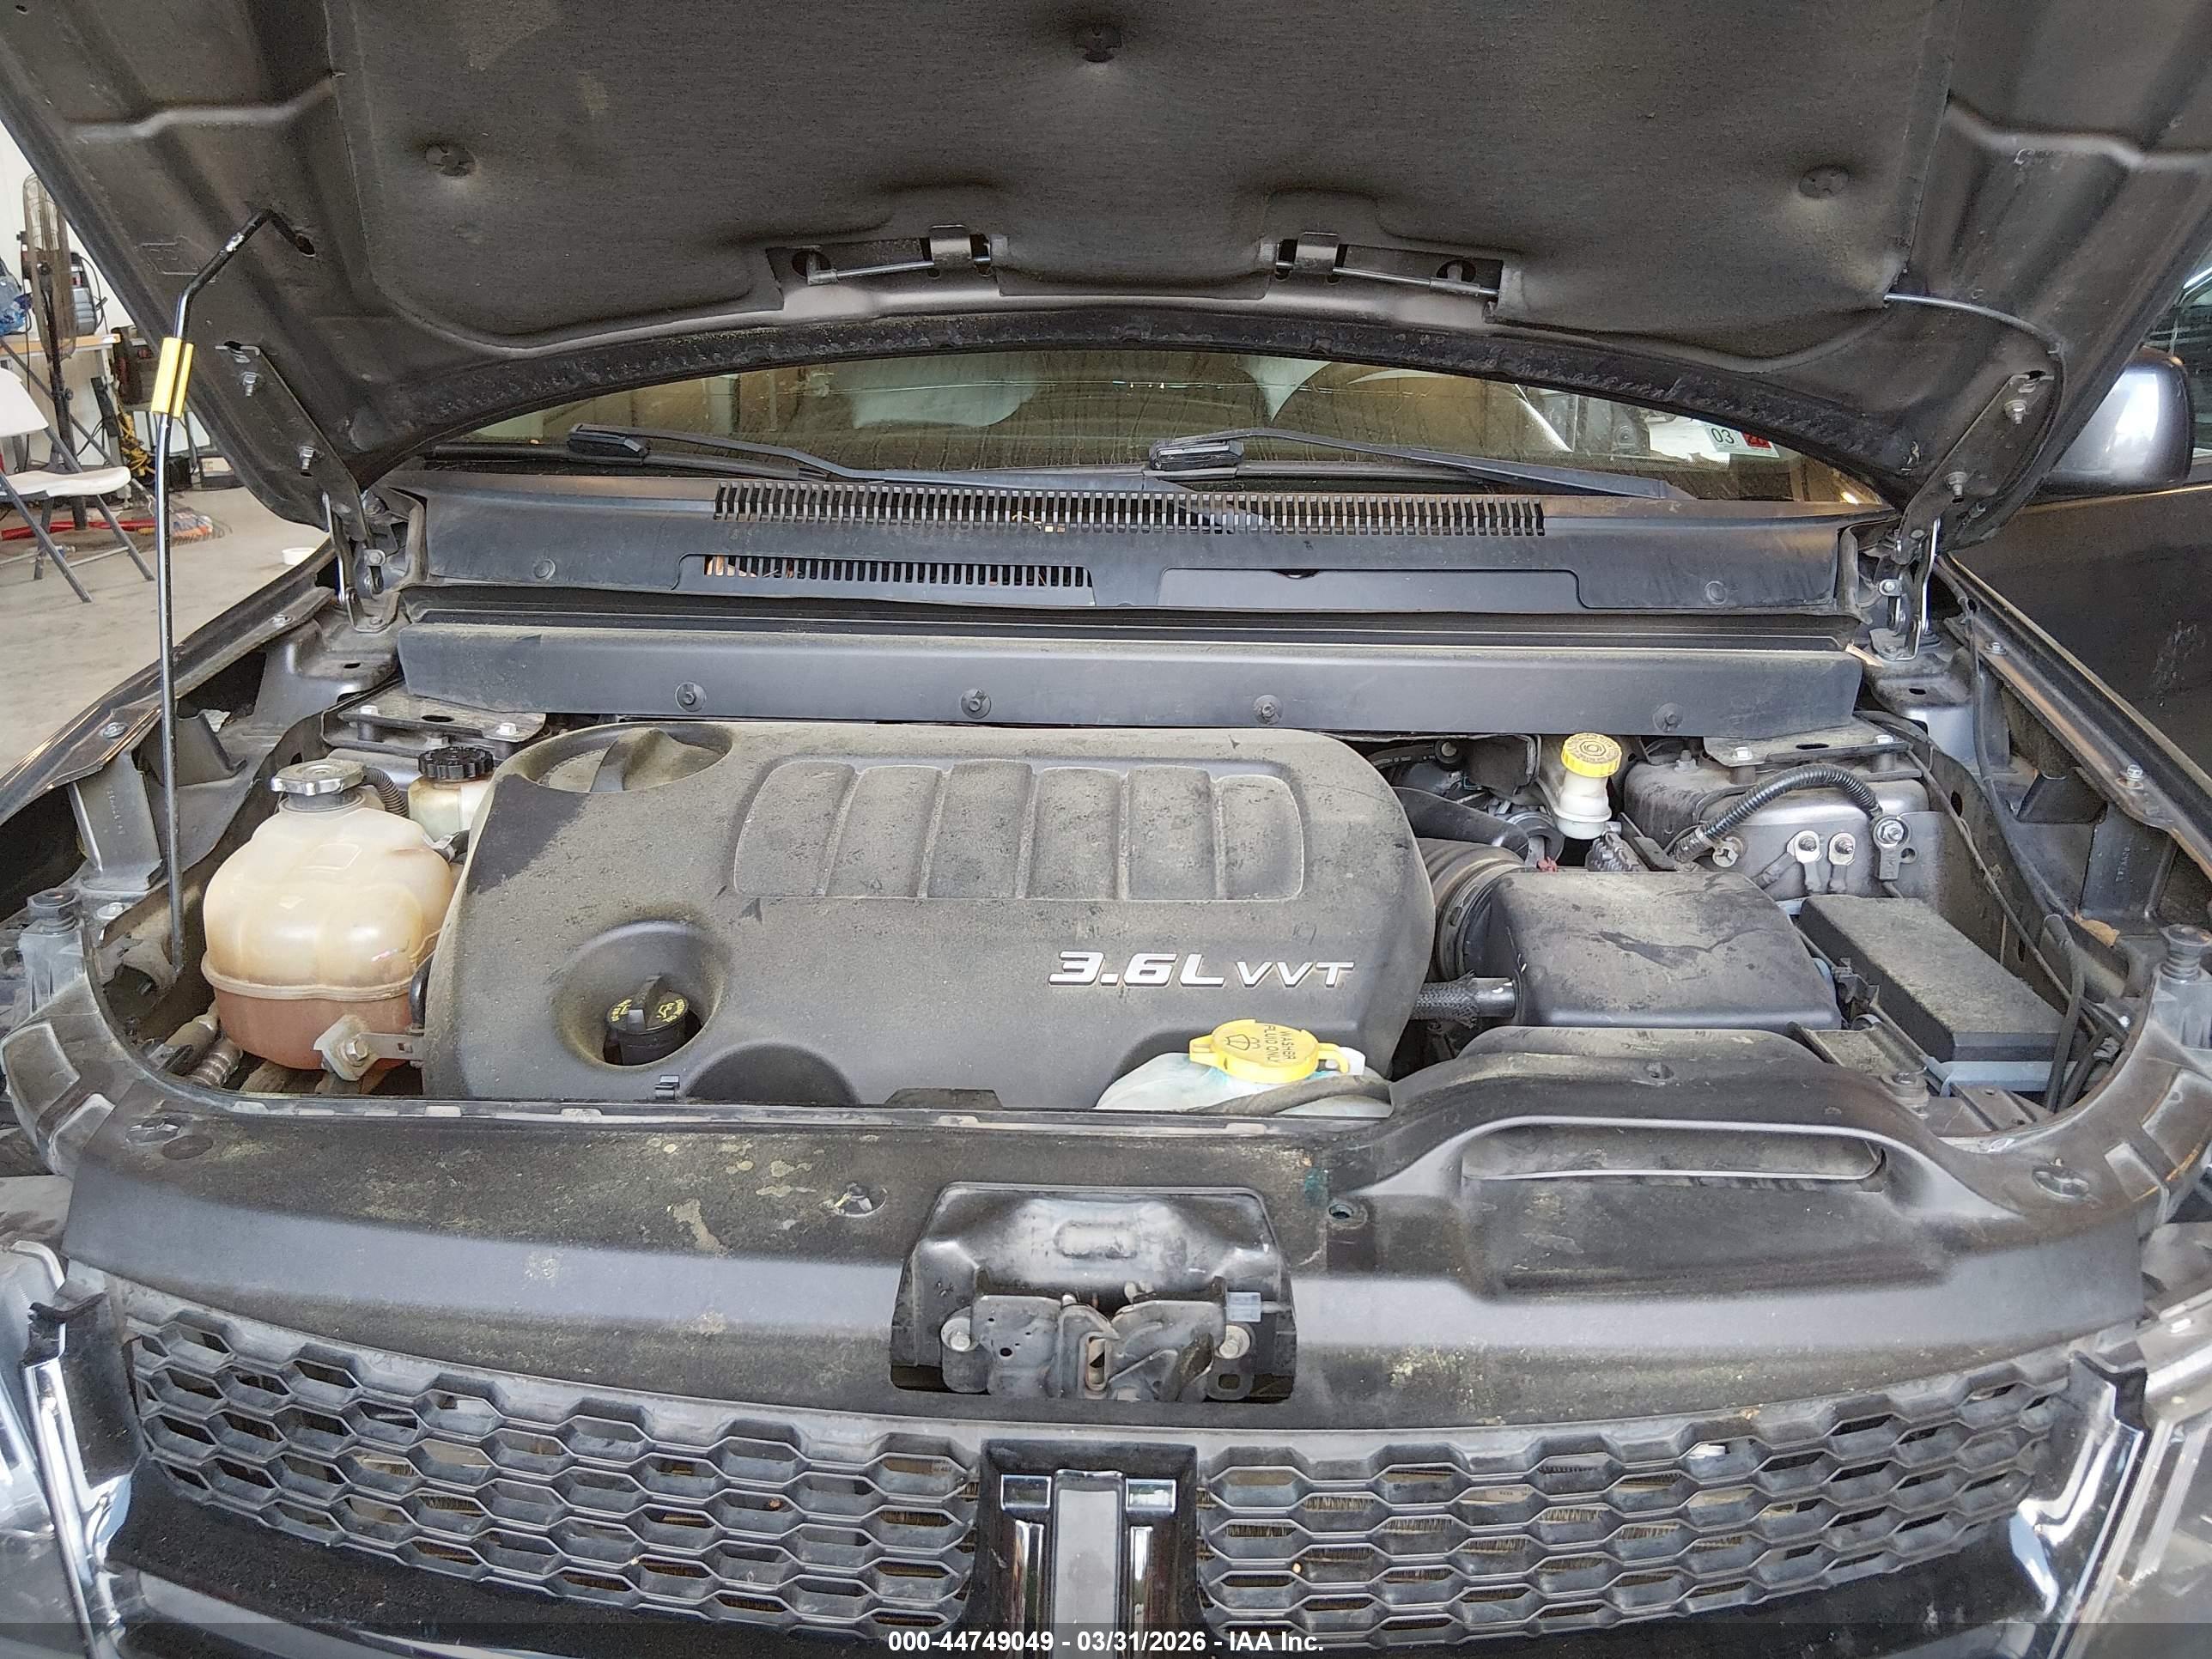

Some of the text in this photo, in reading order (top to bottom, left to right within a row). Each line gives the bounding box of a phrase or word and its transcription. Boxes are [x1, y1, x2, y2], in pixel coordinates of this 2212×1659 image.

[1711, 428, 1735, 445] 03
[1049, 951, 1355, 988] 3.6L VVT
[1264, 1025, 1279, 1063] FLUID ONLY
[1279, 1030, 1297, 1060] WASHER
